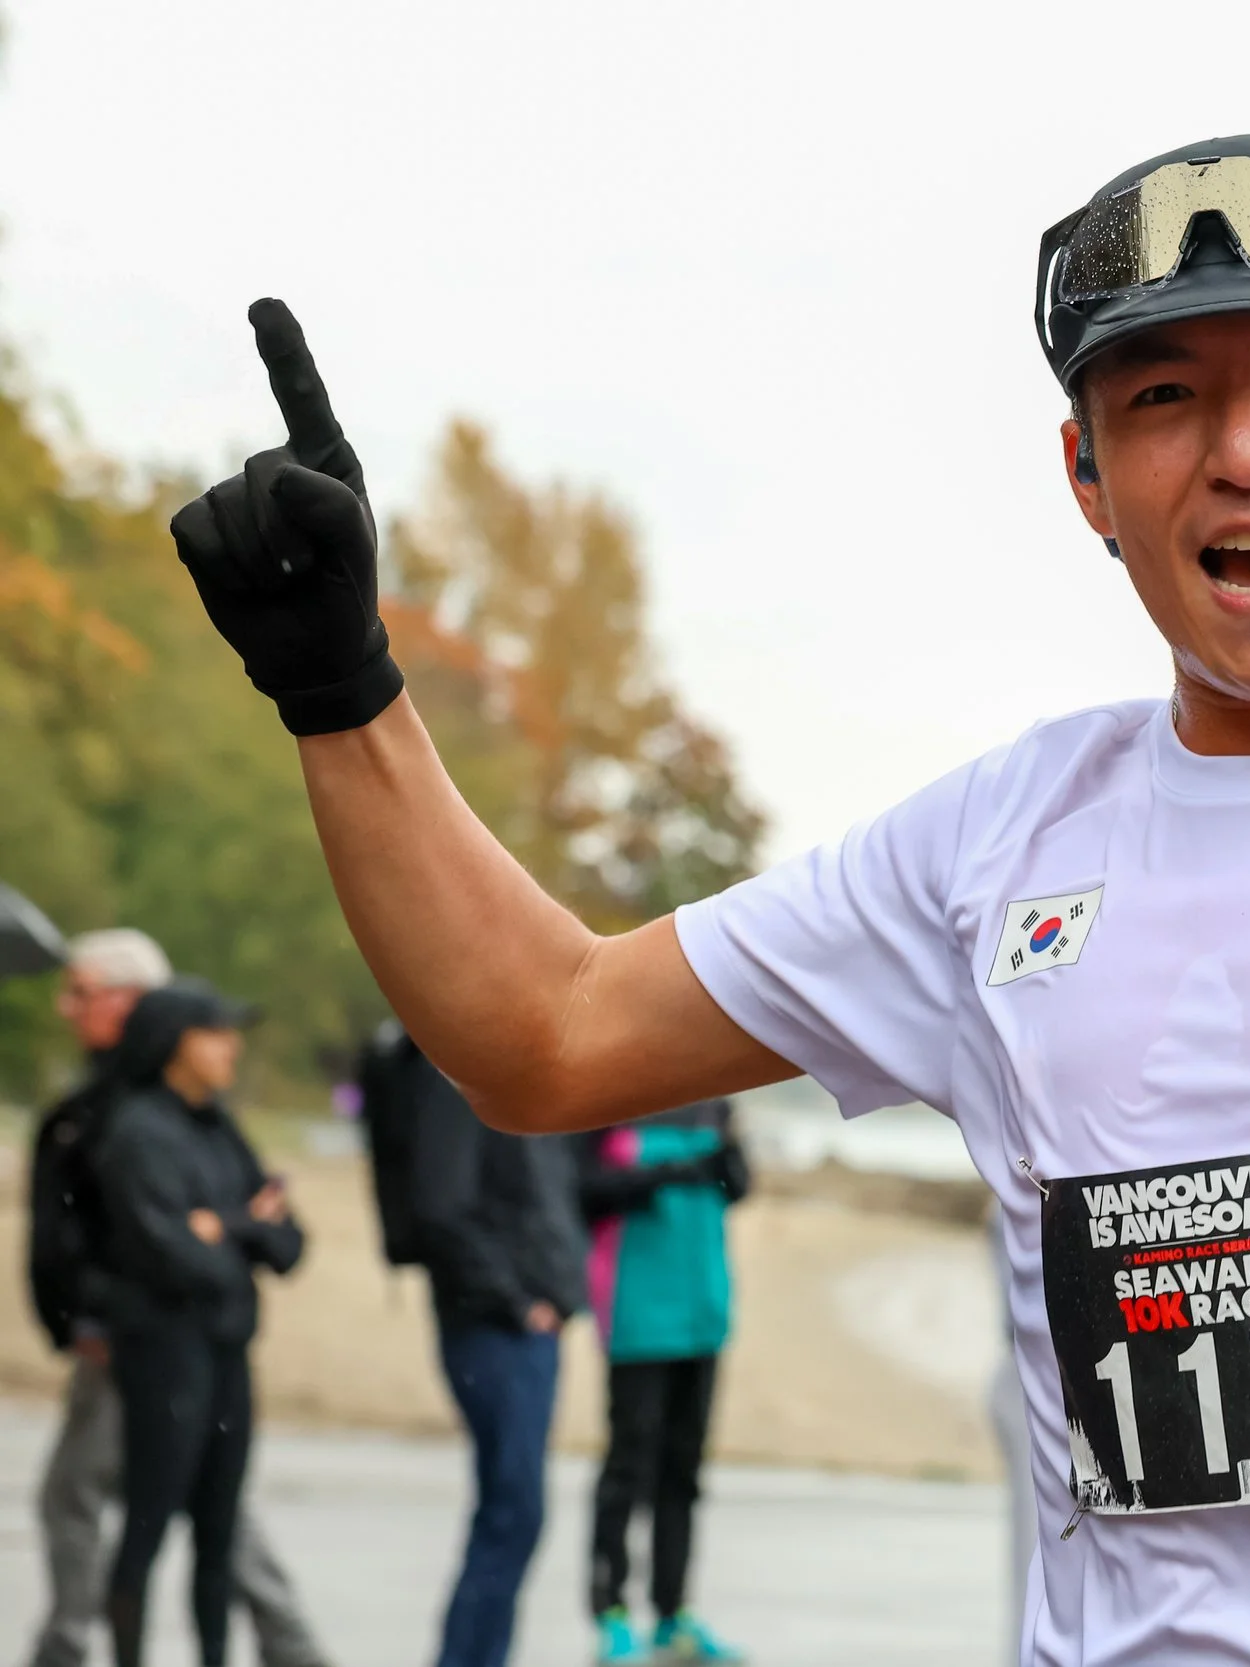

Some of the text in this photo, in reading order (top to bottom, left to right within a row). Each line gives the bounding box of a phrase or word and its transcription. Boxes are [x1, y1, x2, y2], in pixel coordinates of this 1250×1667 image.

[1088, 1216, 1117, 1248] IS
[1133, 1249, 1184, 1265] KAMINO
[1186, 1242, 1221, 1259] RACE
[1118, 1291, 1190, 1333] 10K
